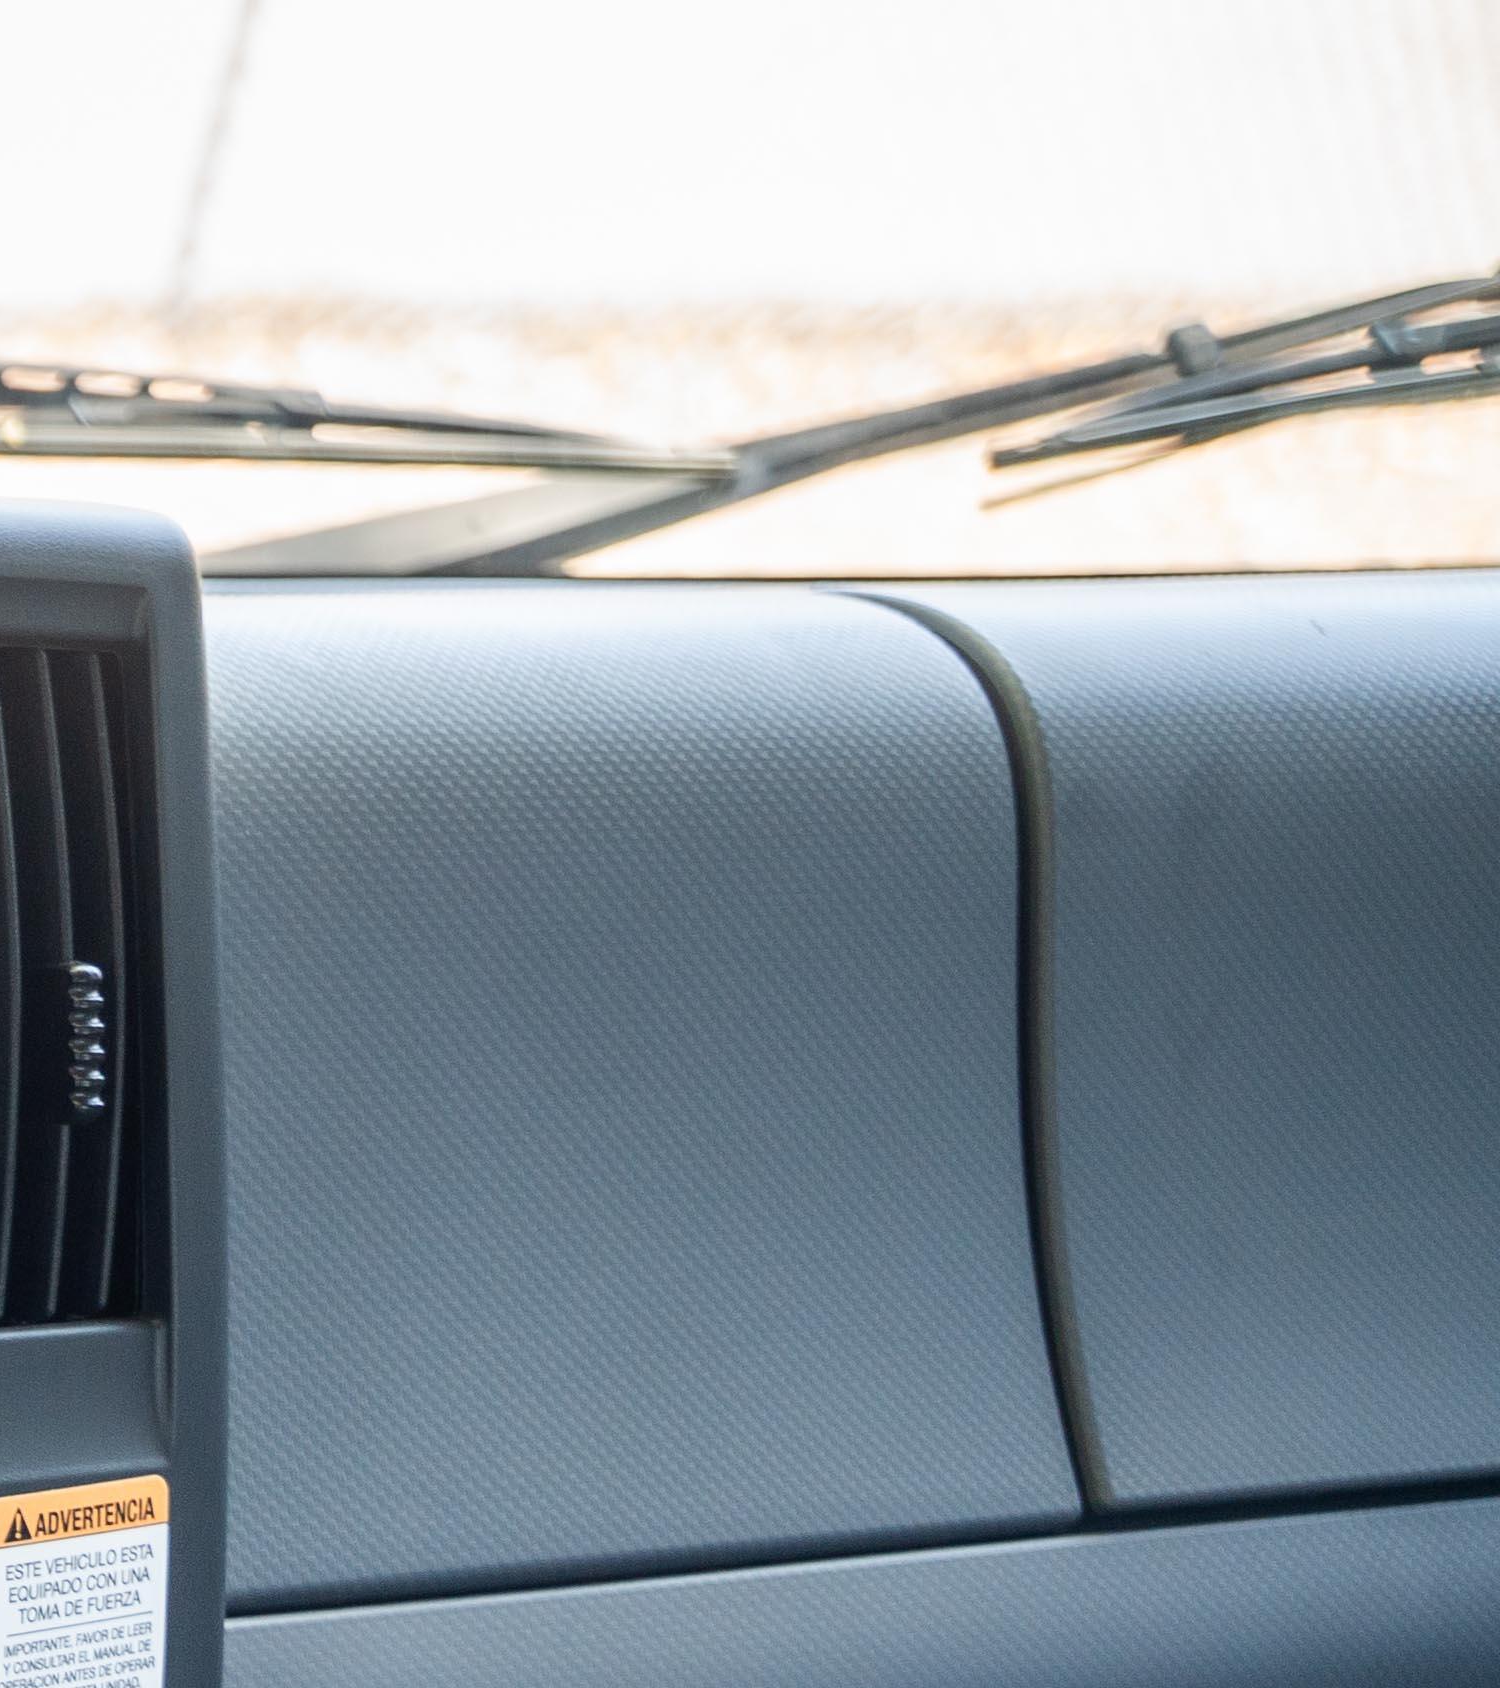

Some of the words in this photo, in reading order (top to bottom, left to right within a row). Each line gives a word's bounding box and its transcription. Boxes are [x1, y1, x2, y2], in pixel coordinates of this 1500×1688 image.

[35, 1497, 155, 1537] ADVERTENCIA
[5, 1561, 42, 1581] ESTE
[45, 1549, 117, 1575] VEHICULO
[121, 1544, 153, 1563] ESTA
[9, 1578, 82, 1604] EQUIPADO
[87, 1572, 117, 1591] CON
[122, 1567, 151, 1584] UNA
[18, 1604, 60, 1624] TOMA
[65, 1600, 84, 1617] DE
[87, 1591, 141, 1613] FUERZA
[75, 1630, 108, 1645] FAVOR
[111, 1626, 125, 1639] DE
[128, 1622, 153, 1636] LEER
[3, 1663, 10, 1675] Y
[14, 1652, 76, 1674] CONSULTAR
[79, 1651, 90, 1663] EL
[93, 1643, 135, 1661] MANUAL
[138, 1639, 152, 1652] DE
[63, 1668, 95, 1684] ANTES
[99, 1664, 112, 1677] DE
[115, 1656, 155, 1675] OPERAR
